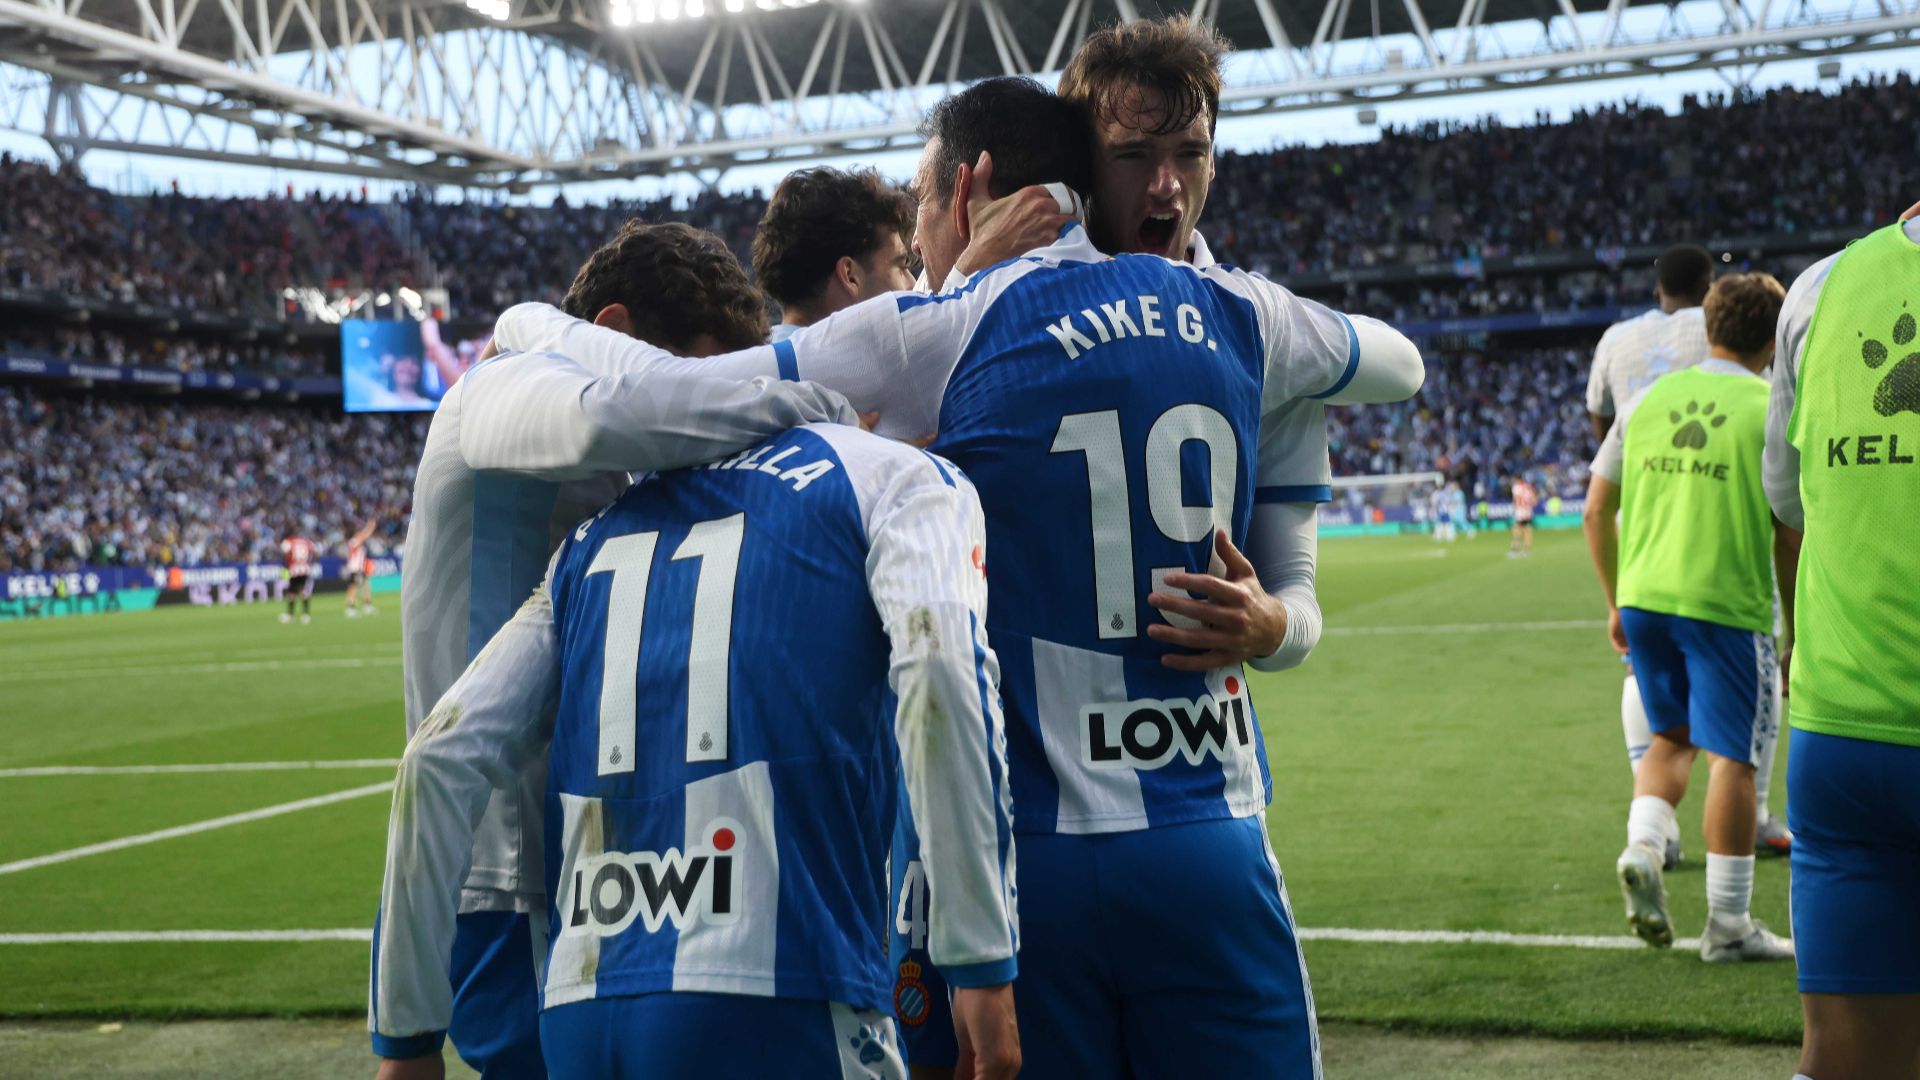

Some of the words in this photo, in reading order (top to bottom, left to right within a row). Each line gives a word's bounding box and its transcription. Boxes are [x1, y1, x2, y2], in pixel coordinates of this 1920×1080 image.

[1046, 295, 1166, 360] KIKE
[1177, 303, 1218, 352] G.
[692, 444, 836, 492] ILLA
[1643, 456, 1730, 482] KELME
[1049, 403, 1239, 640] 19
[585, 512, 746, 776] 11
